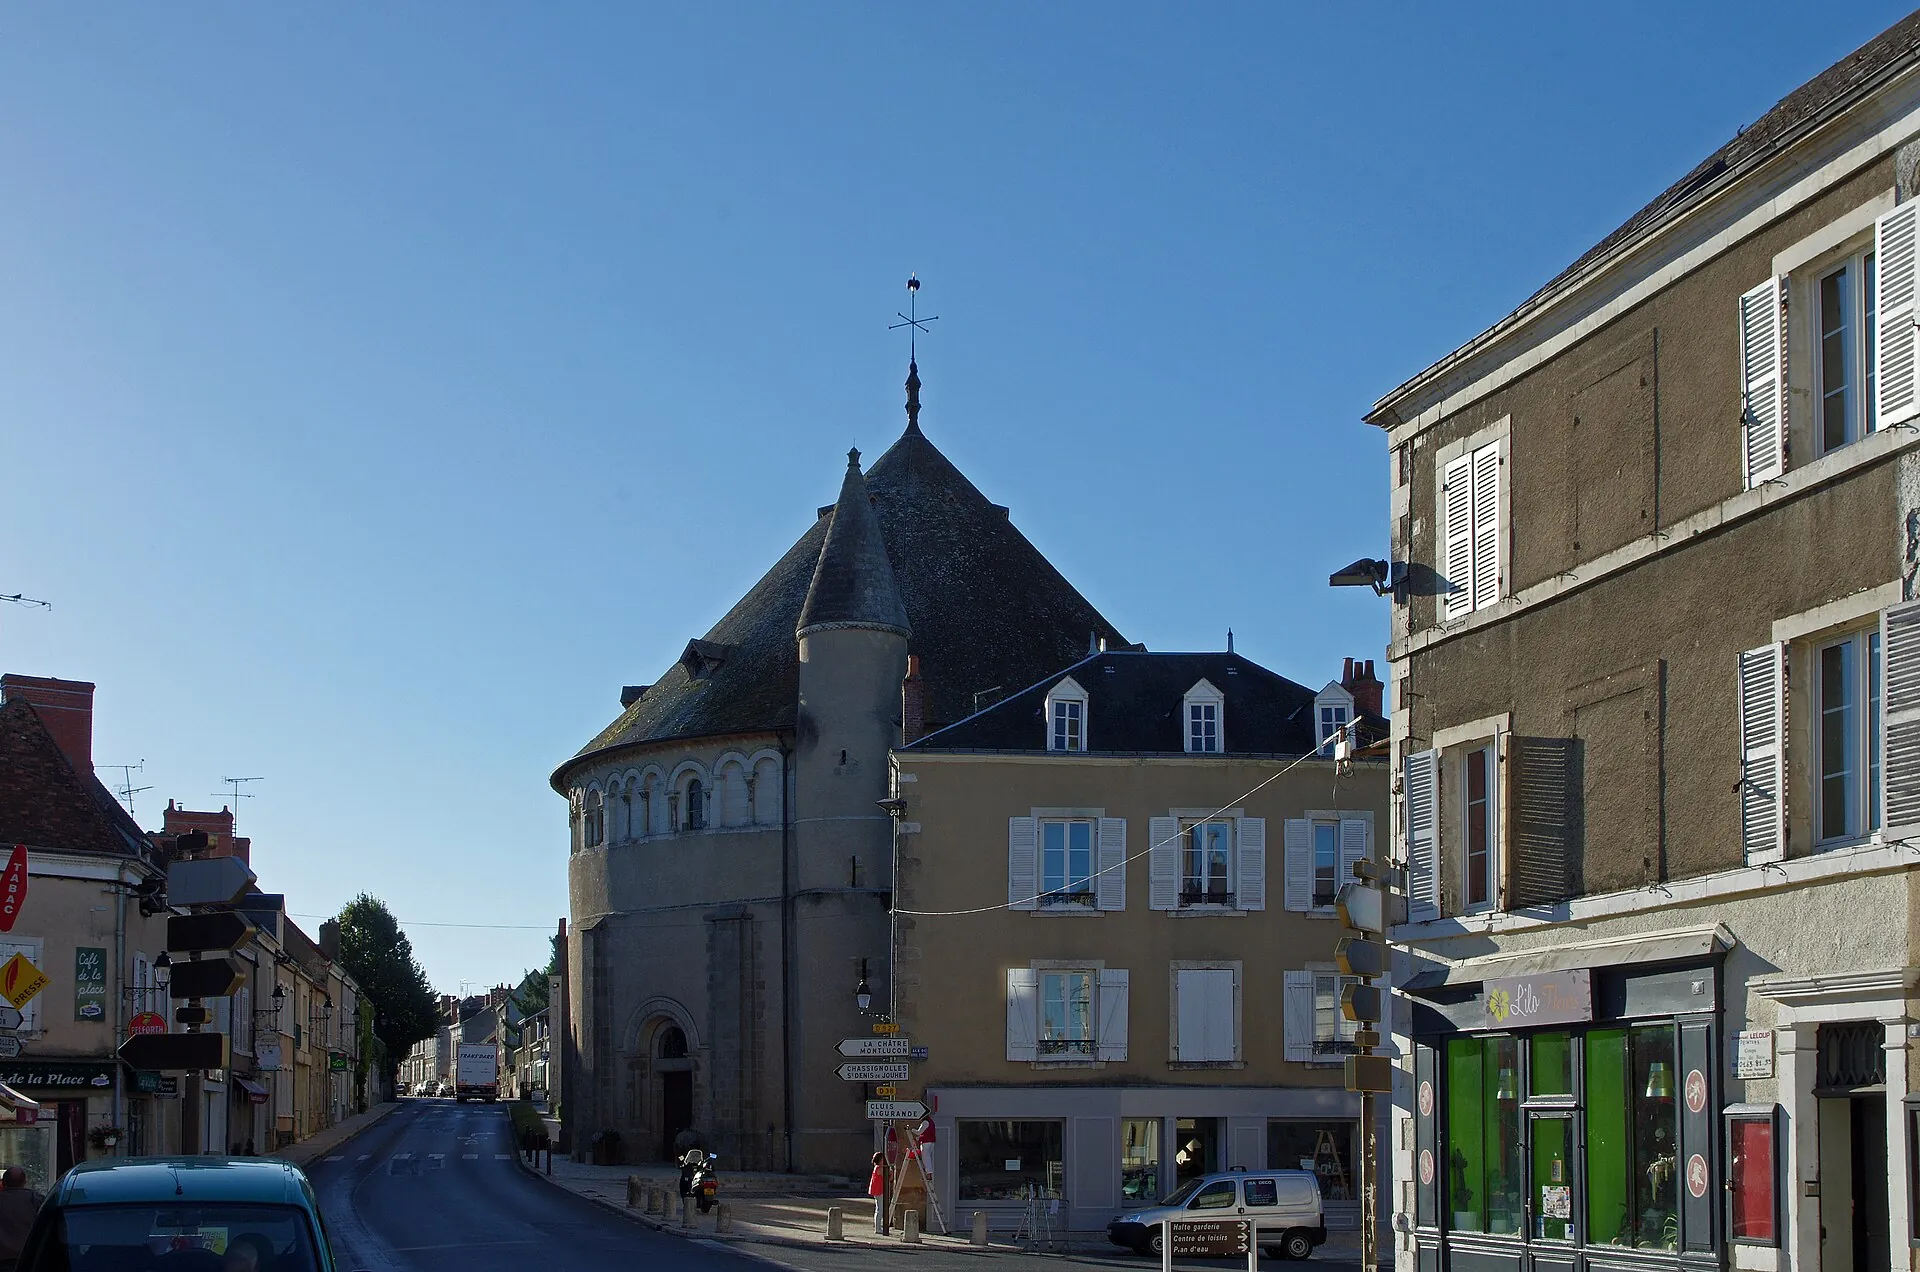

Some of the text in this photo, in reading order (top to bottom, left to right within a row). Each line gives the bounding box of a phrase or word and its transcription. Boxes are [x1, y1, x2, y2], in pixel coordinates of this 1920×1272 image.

[4, 863, 22, 915] TABAC
[78, 952, 99, 970] Café
[78, 967, 102, 981] de la
[13, 975, 47, 1006] PRESSE
[77, 982, 106, 999] place
[130, 1026, 164, 1034] PELFORTH
[877, 1039, 908, 1048] CHÂTRE
[7, 1073, 25, 1085] de
[27, 1073, 43, 1085] la
[46, 1073, 85, 1085] Place
[870, 1110, 918, 1118] AIGURANDE
[1173, 1223, 1220, 1232] Halte garderie
[1173, 1234, 1228, 1243] Centre de loisirs
